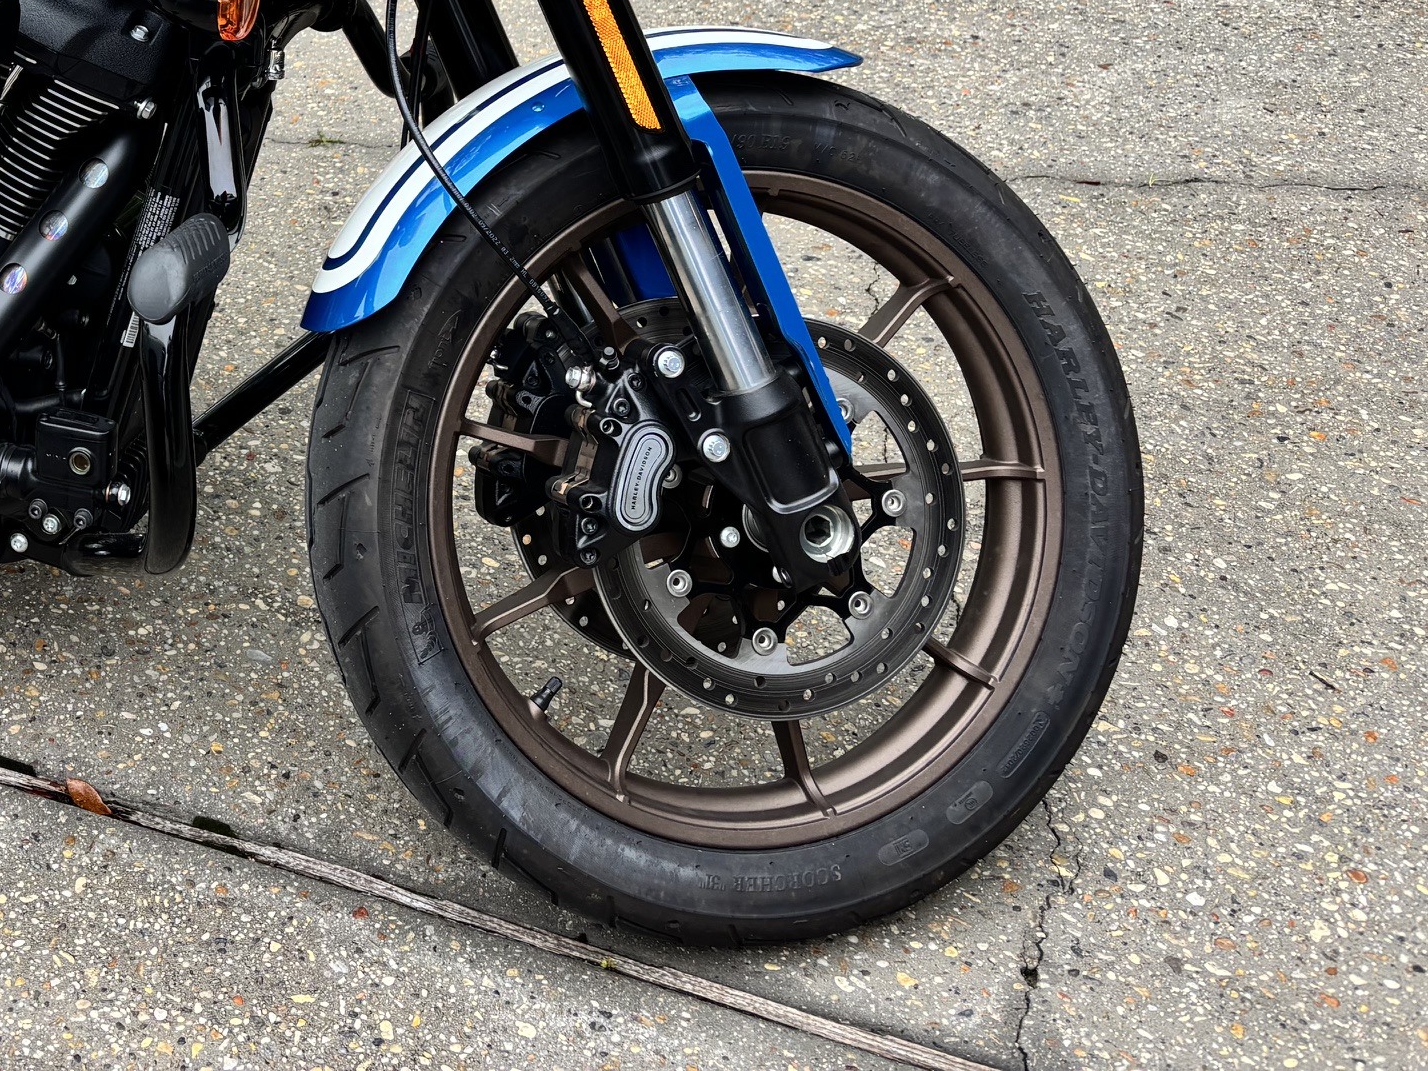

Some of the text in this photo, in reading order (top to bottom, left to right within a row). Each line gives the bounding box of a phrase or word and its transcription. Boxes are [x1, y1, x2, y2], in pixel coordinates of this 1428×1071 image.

[394, 391, 434, 605] MICHELIN
[630, 446, 653, 510] HARLEY-DAVIDSON
[1022, 289, 1112, 686] HARLEY-DAVIDSON
[732, 863, 843, 893] SCORCHER
